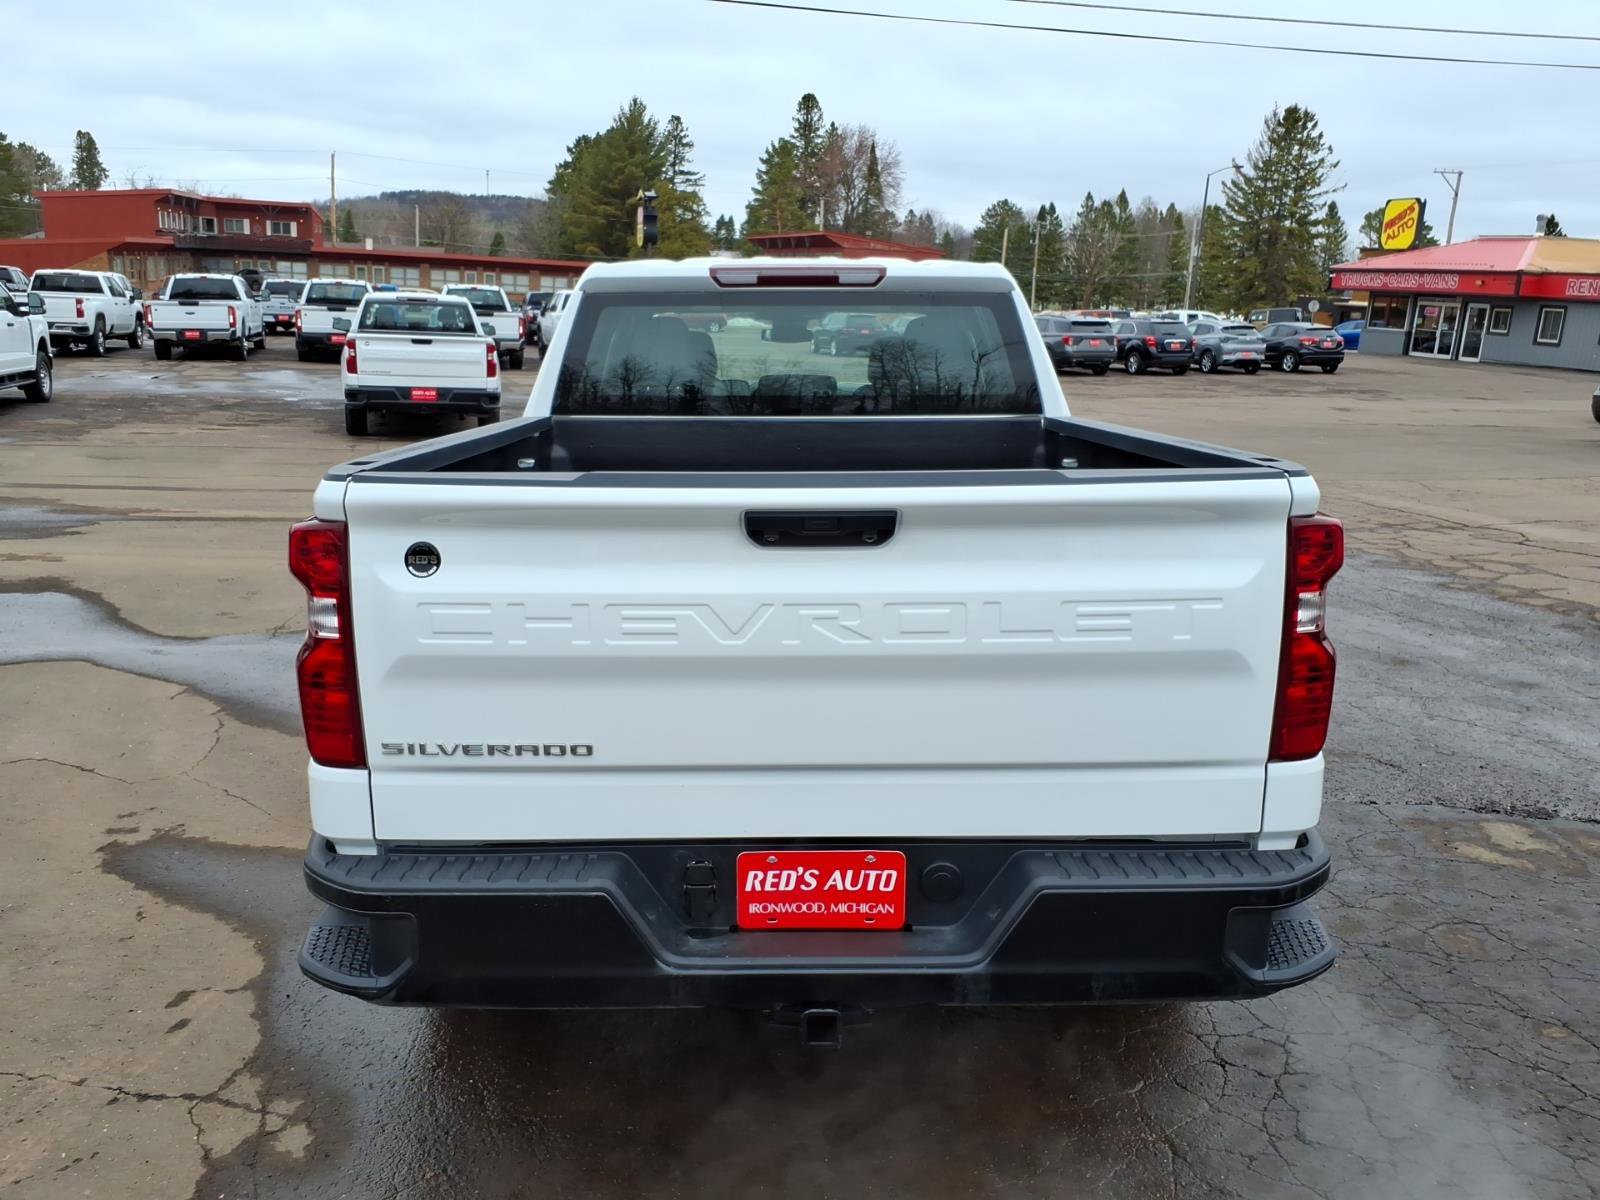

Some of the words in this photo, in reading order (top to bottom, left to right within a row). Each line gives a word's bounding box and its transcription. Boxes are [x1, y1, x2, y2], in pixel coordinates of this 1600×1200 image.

[1384, 217, 1415, 246] AUTO
[416, 597, 1224, 645] CHEVROLET
[381, 742, 594, 757] SILVERADO
[744, 866, 820, 892] RED'S
[823, 869, 898, 892] AUTO
[749, 902, 828, 915] IRONWOOD,
[829, 902, 895, 915] MICHIGAN
